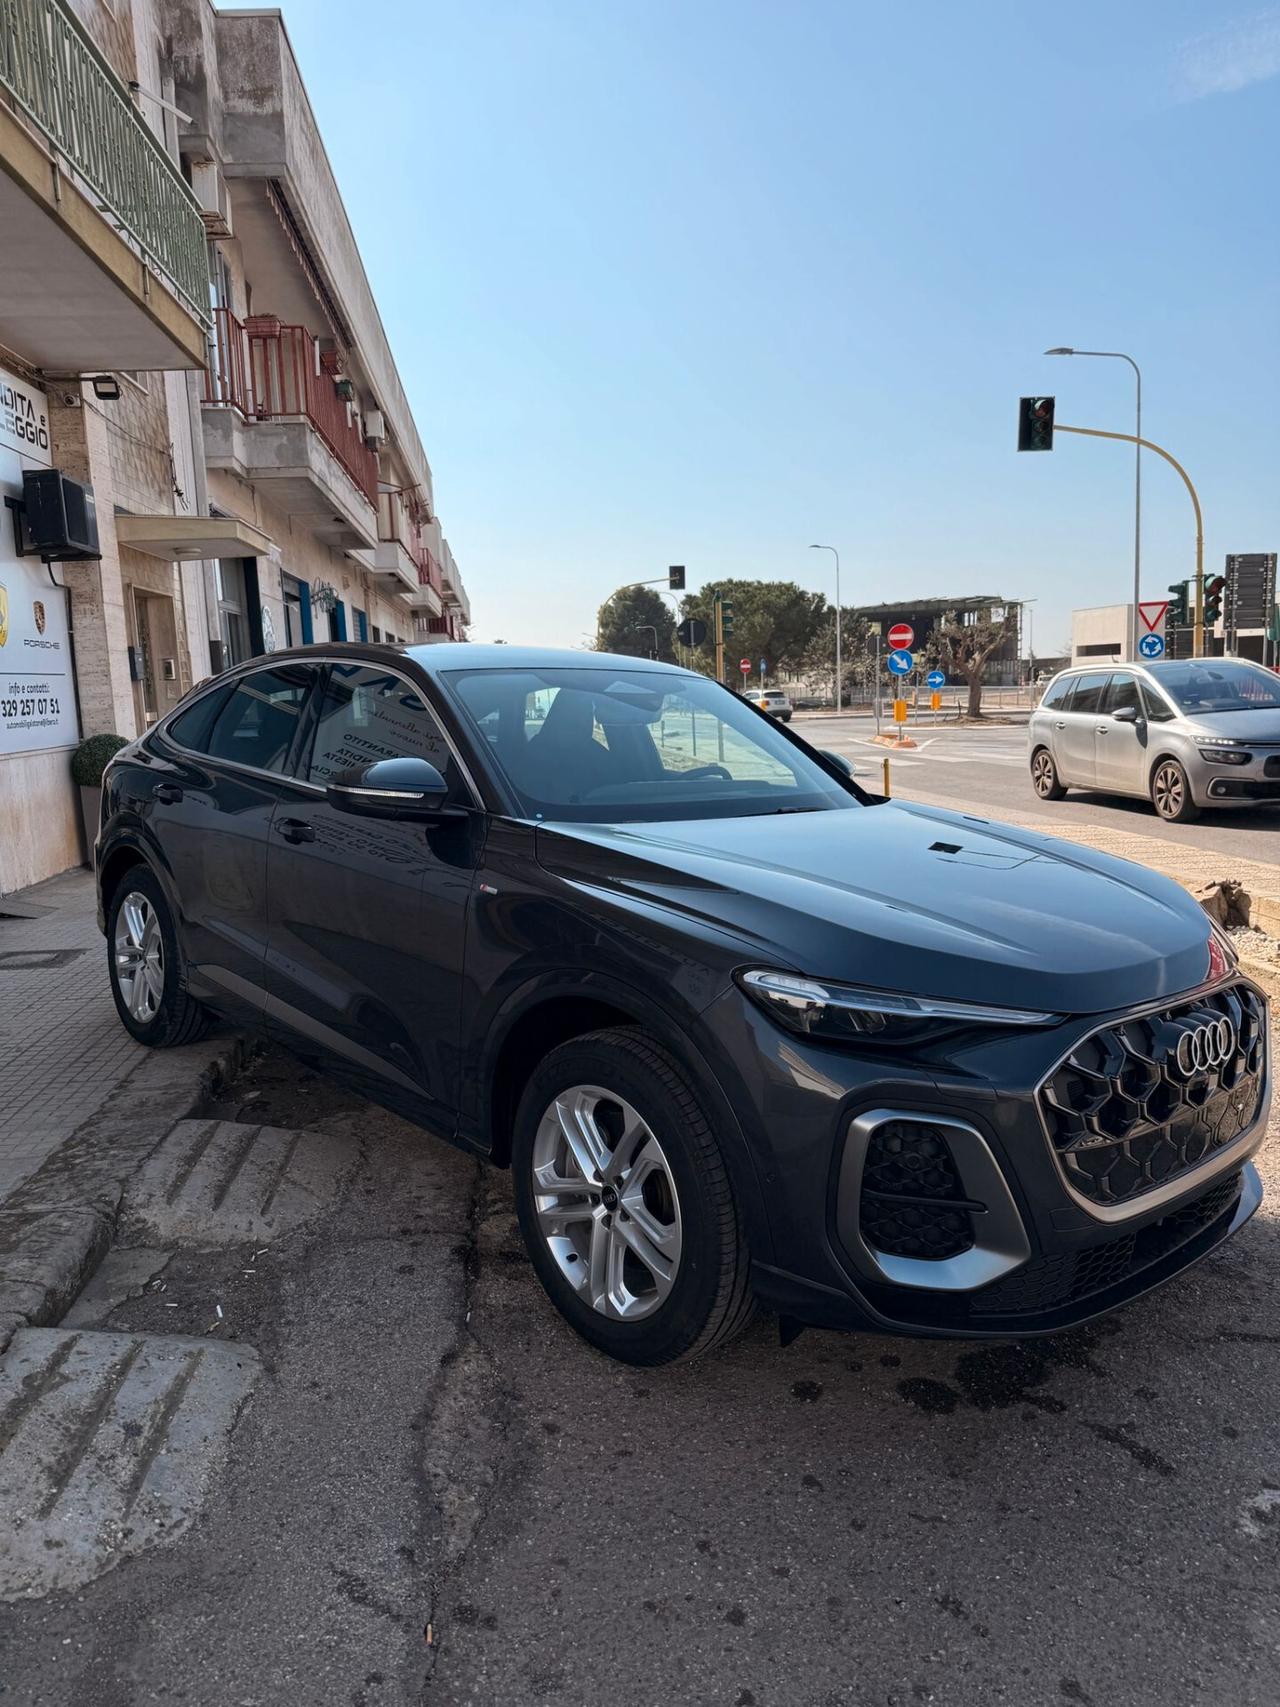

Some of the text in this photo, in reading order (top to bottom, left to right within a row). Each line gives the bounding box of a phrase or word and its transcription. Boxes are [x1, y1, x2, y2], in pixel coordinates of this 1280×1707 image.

[24, 639, 60, 649] PORSCHE
[9, 682, 20, 696] info
[1, 698, 60, 717] 329 257 07 51
